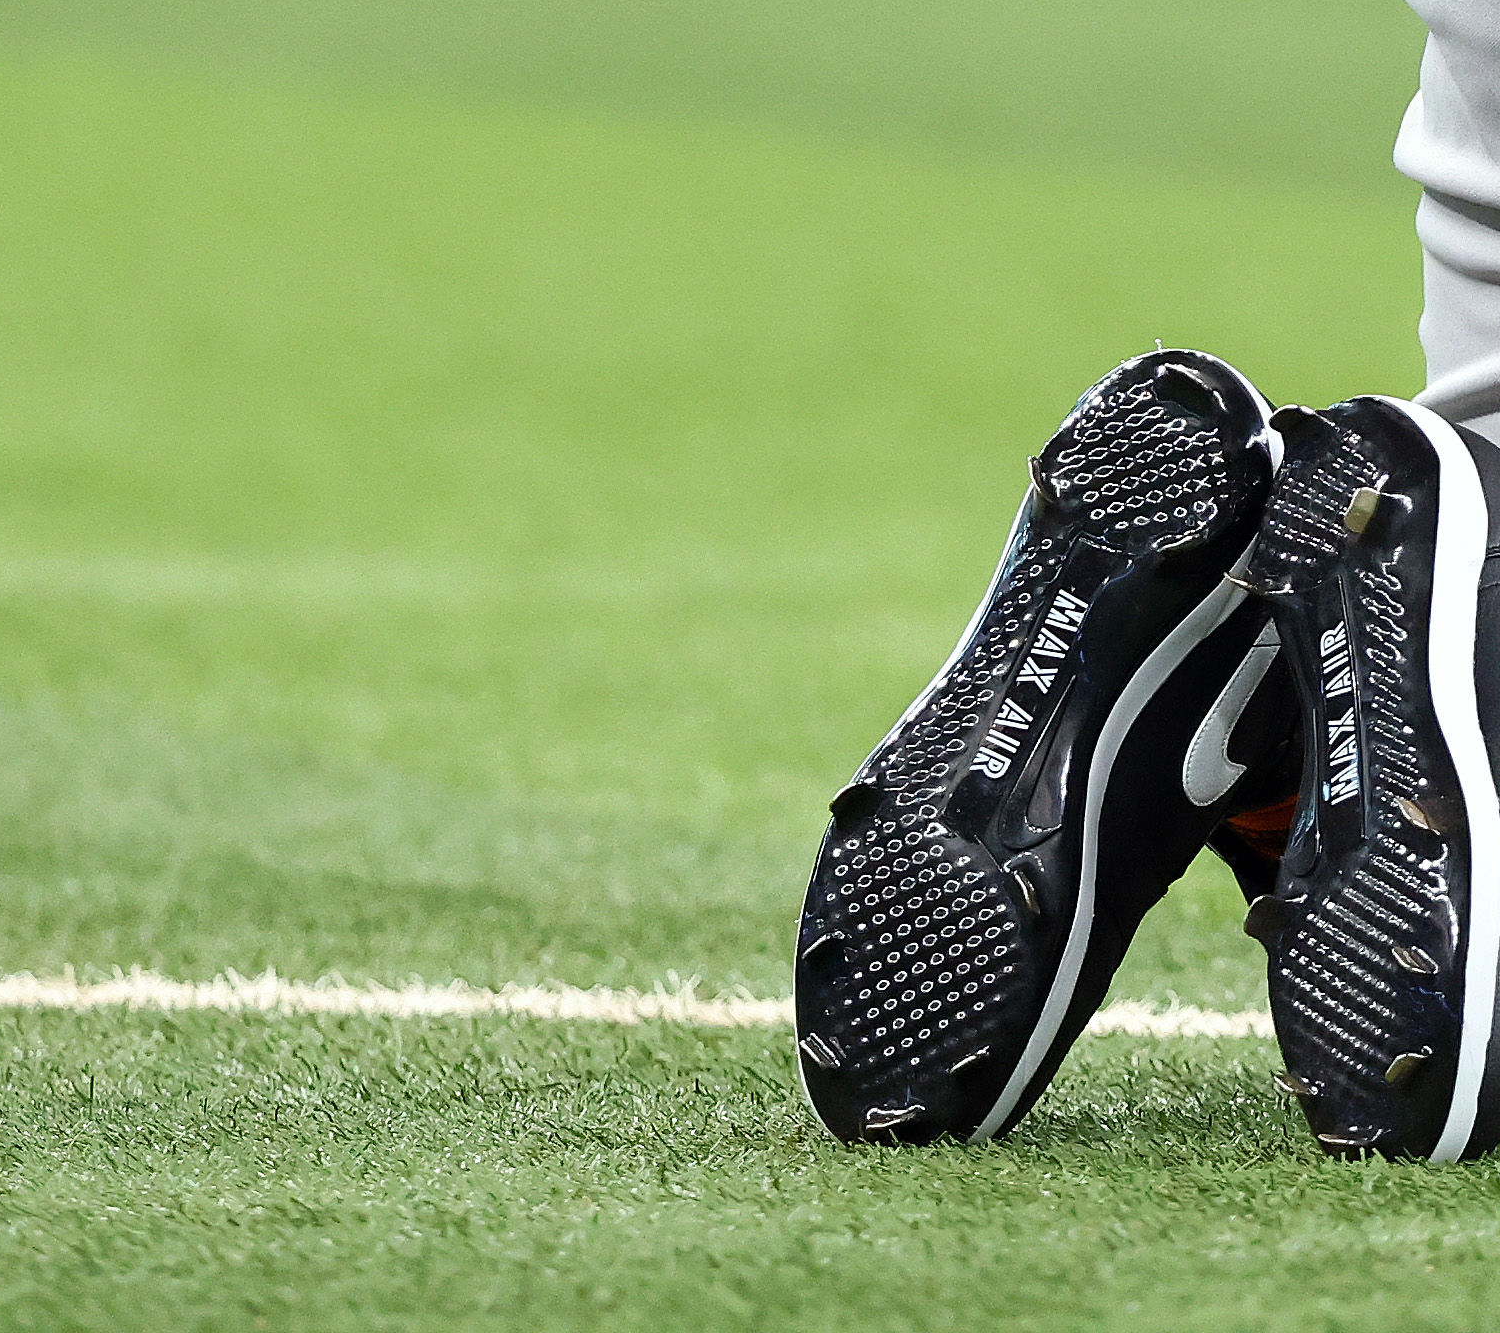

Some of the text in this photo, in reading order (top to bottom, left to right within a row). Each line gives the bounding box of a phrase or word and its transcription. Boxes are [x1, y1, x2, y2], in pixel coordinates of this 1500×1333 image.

[969, 588, 1089, 780] MAX AIR
[1320, 619, 1360, 806] MAX AIR
